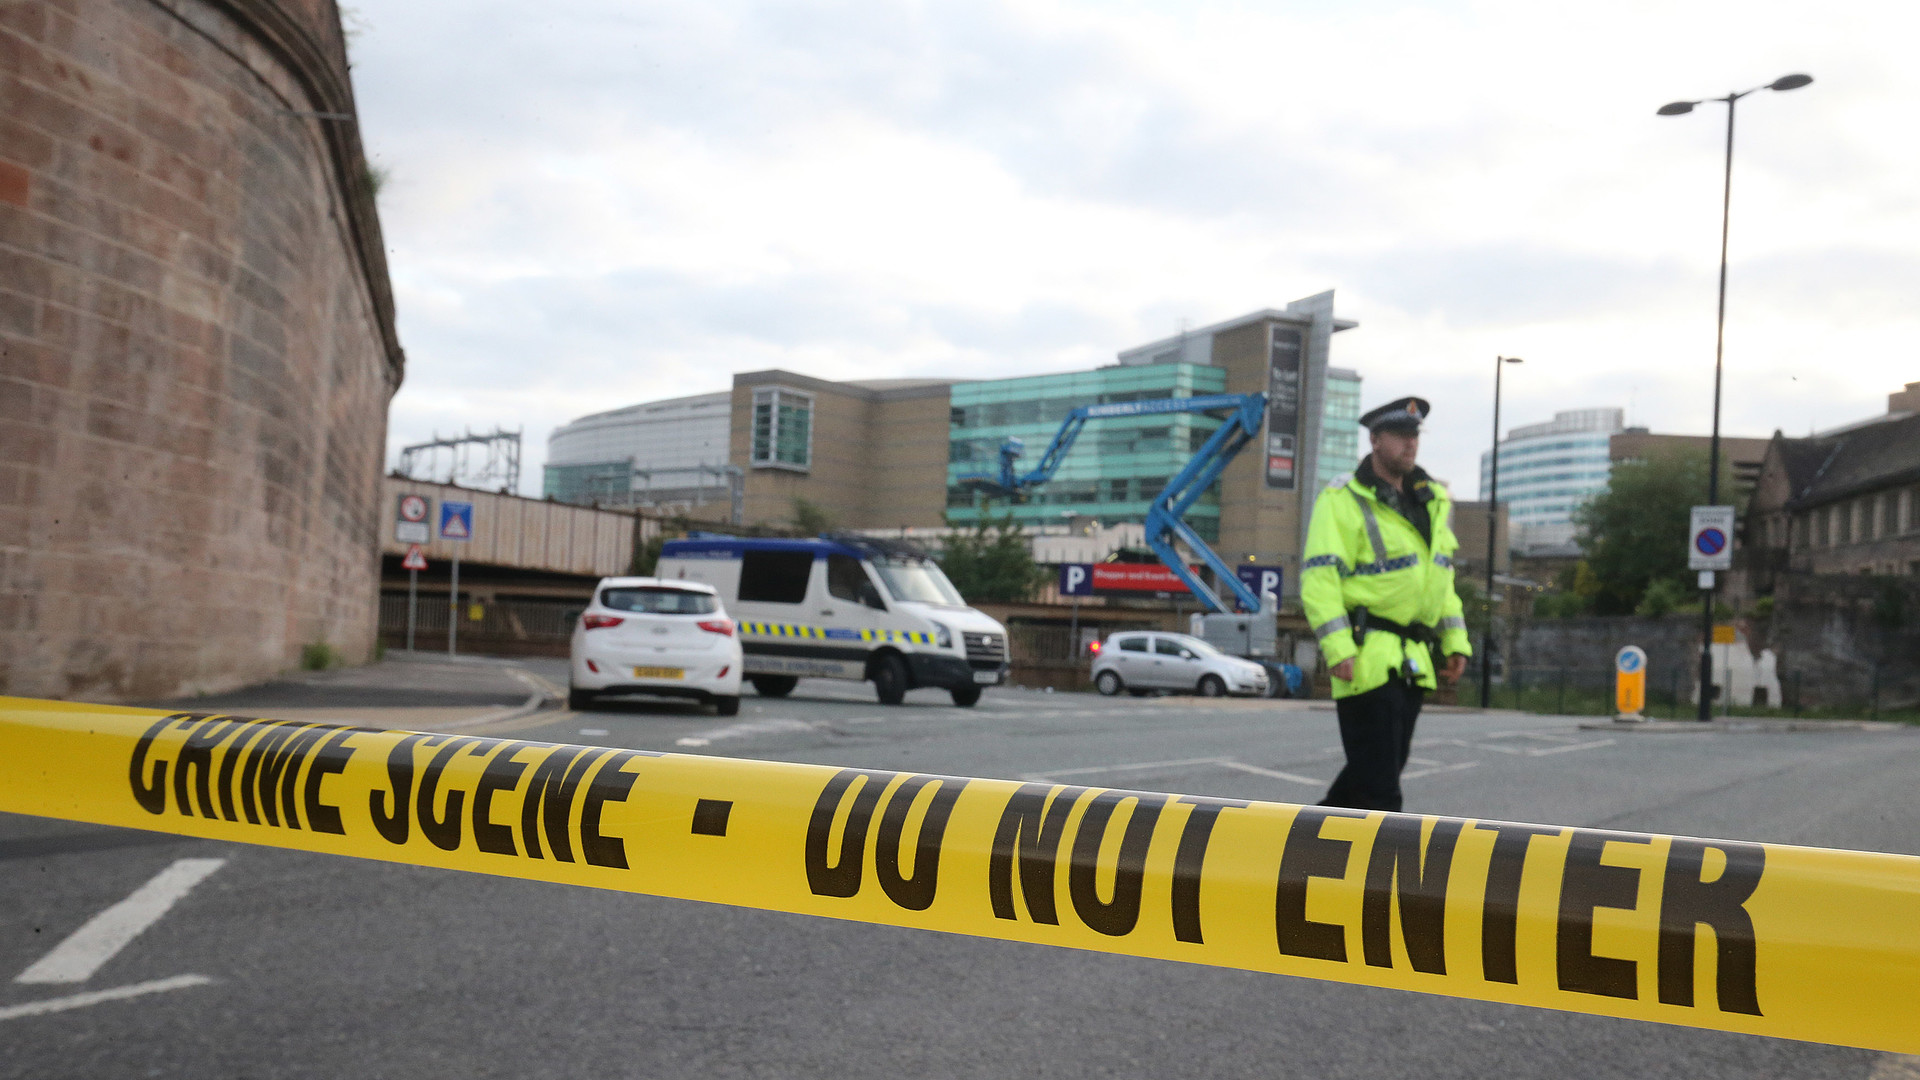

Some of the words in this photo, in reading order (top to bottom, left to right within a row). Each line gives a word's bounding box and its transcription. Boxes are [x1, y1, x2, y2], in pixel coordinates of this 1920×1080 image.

[1067, 566, 1086, 593] P
[1261, 570, 1279, 594] P
[129, 712, 398, 835] CRIME
[370, 732, 664, 870] SCENE
[805, 768, 971, 911] DO
[989, 782, 1247, 945] NOT
[1276, 805, 1765, 1017] ENTER
